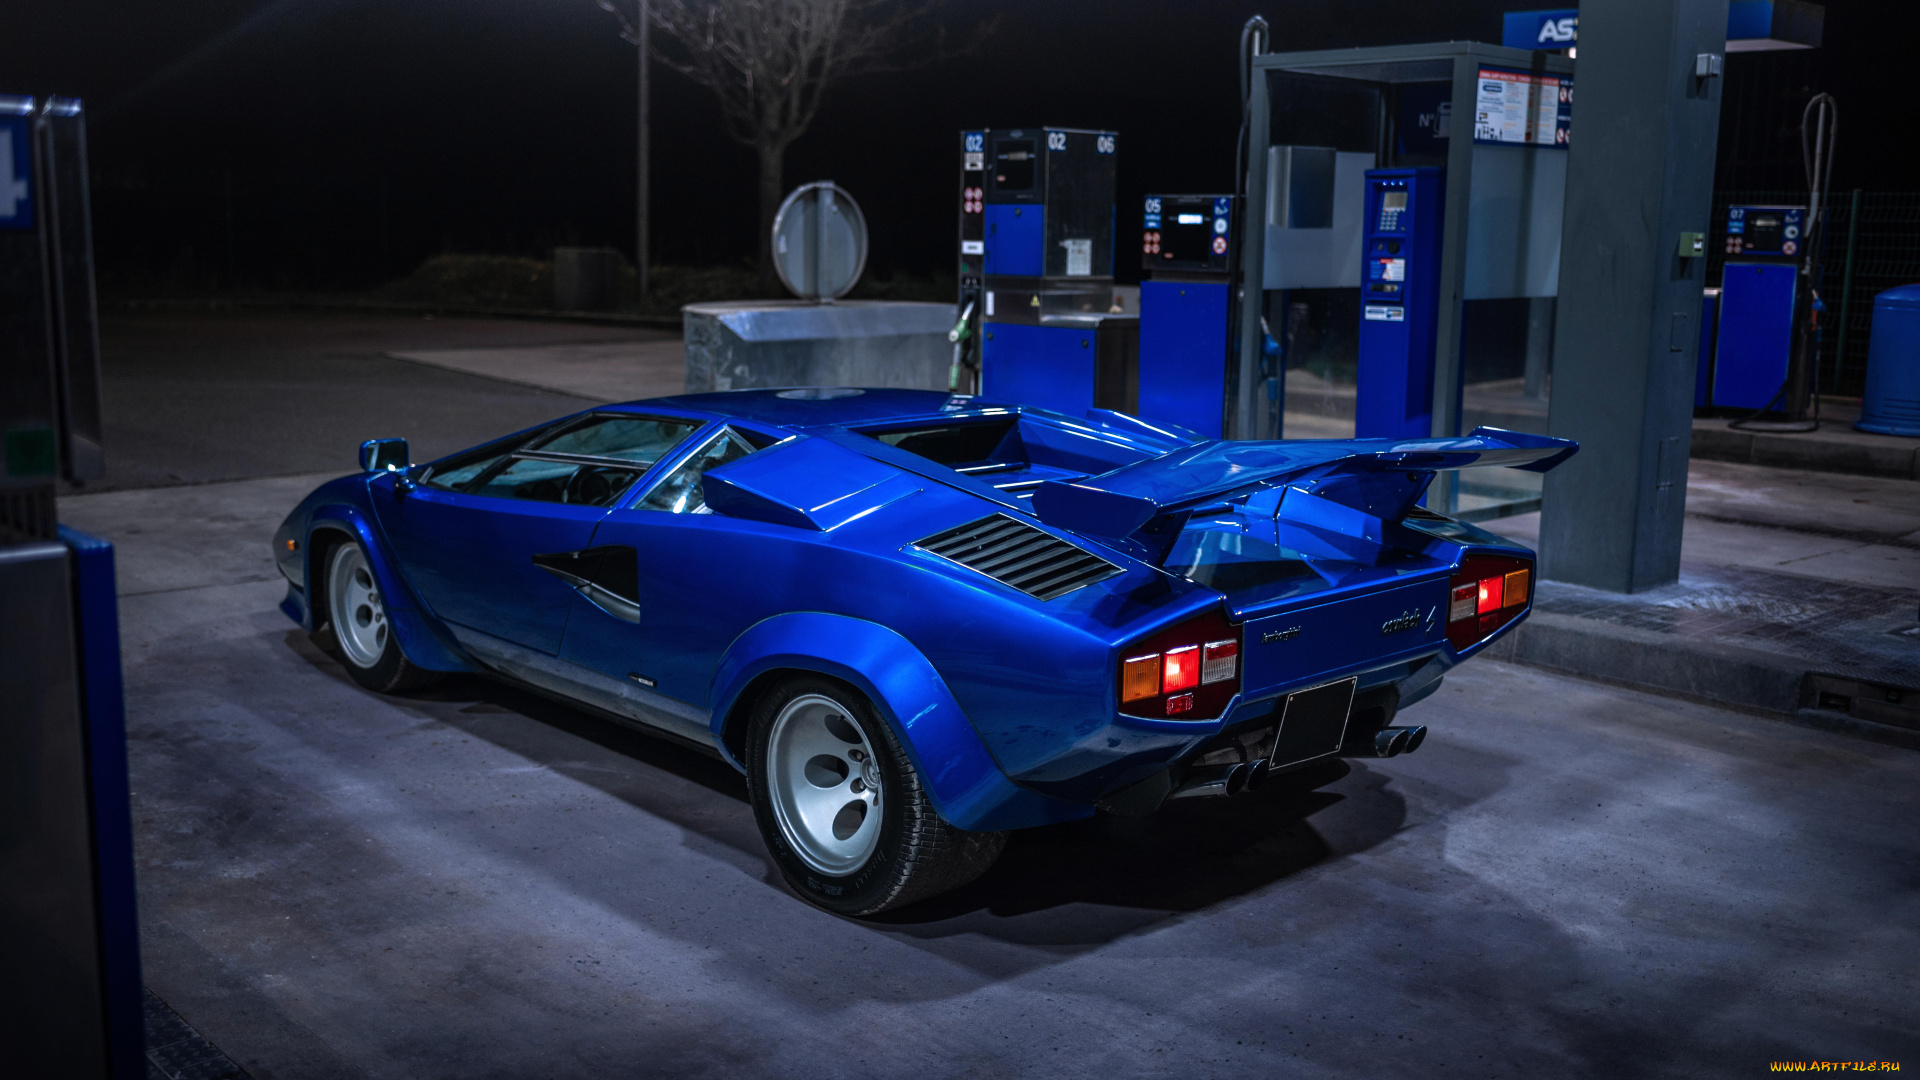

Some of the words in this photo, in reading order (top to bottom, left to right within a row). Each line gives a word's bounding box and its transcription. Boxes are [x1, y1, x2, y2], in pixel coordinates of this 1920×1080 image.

[1538, 17, 1578, 42] AS
[965, 134, 984, 152] 02
[1048, 132, 1067, 151] 02
[1145, 198, 1161, 214] 05
[1730, 208, 1745, 220] 07
